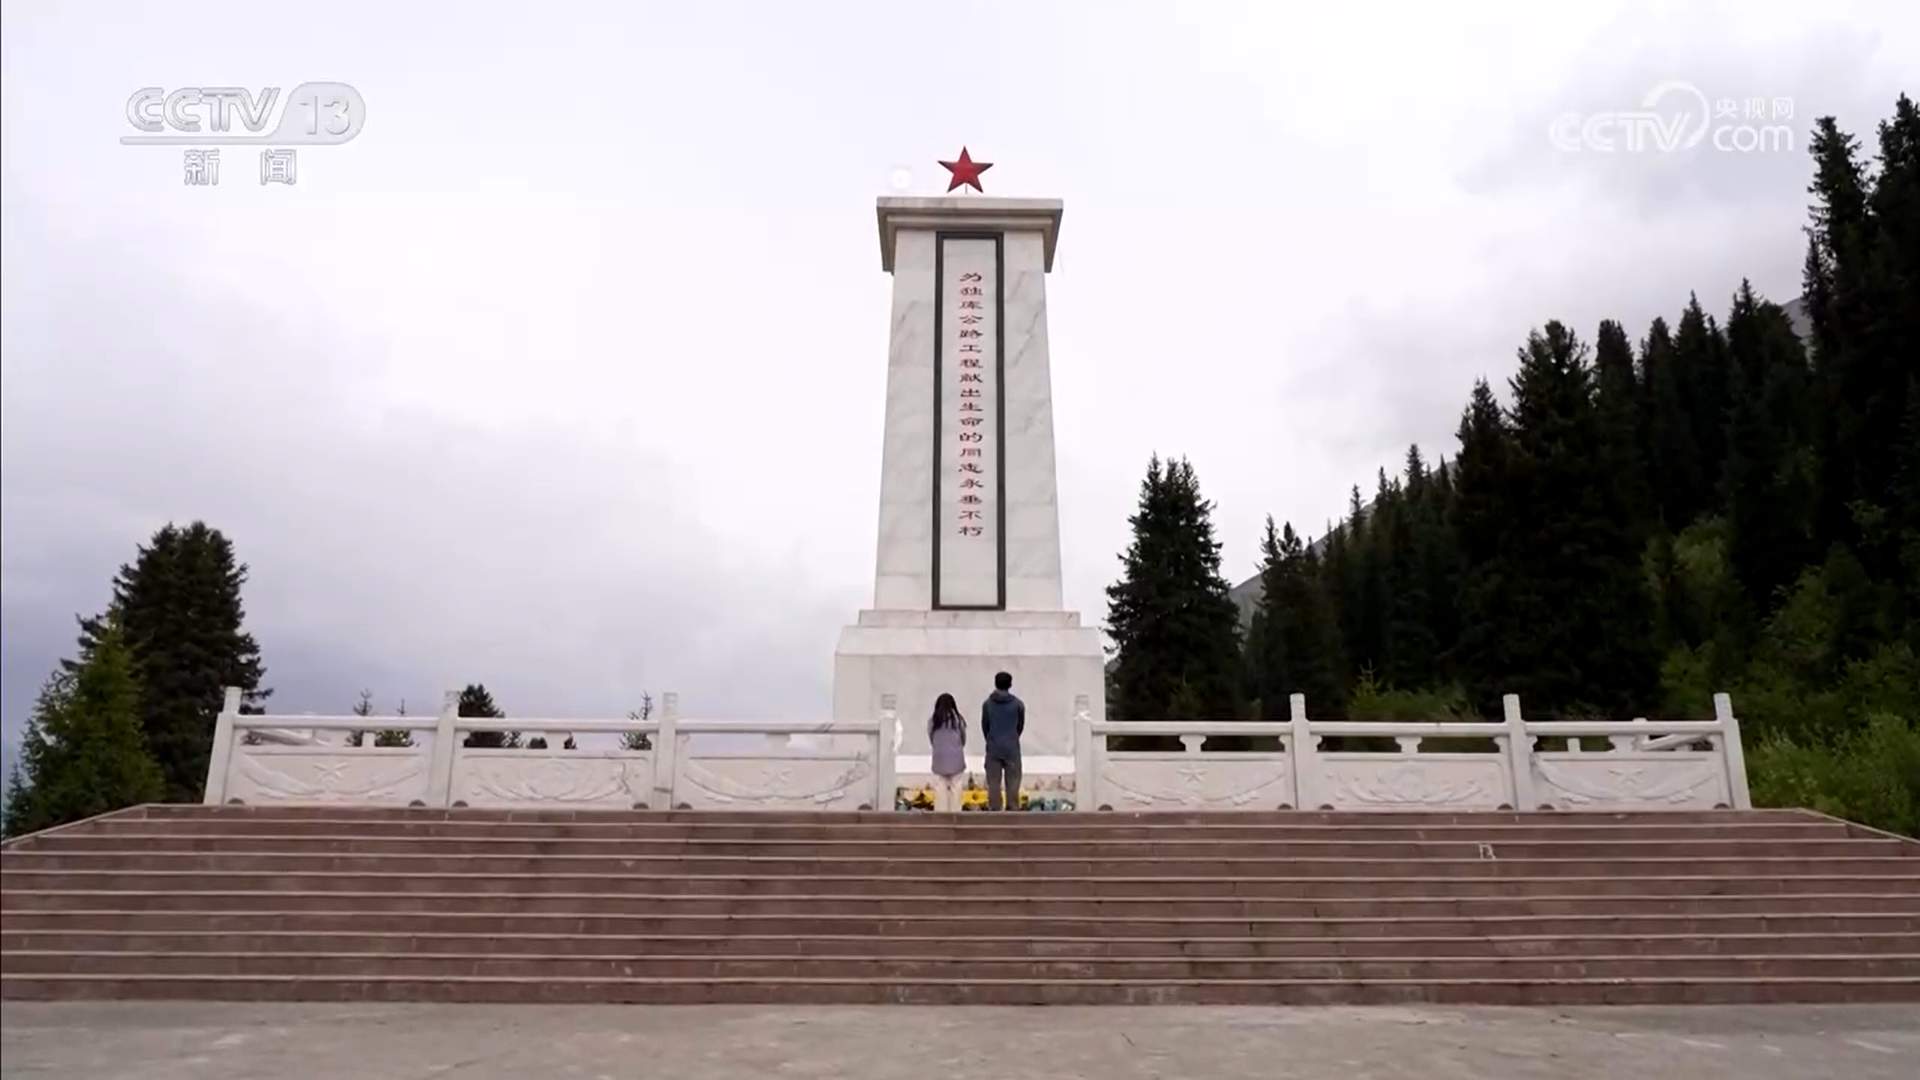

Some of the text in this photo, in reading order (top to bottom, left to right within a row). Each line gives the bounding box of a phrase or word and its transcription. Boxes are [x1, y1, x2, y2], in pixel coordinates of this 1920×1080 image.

[958, 272, 984, 536] 为独库公路工程献出生命的同志永垂不朽
